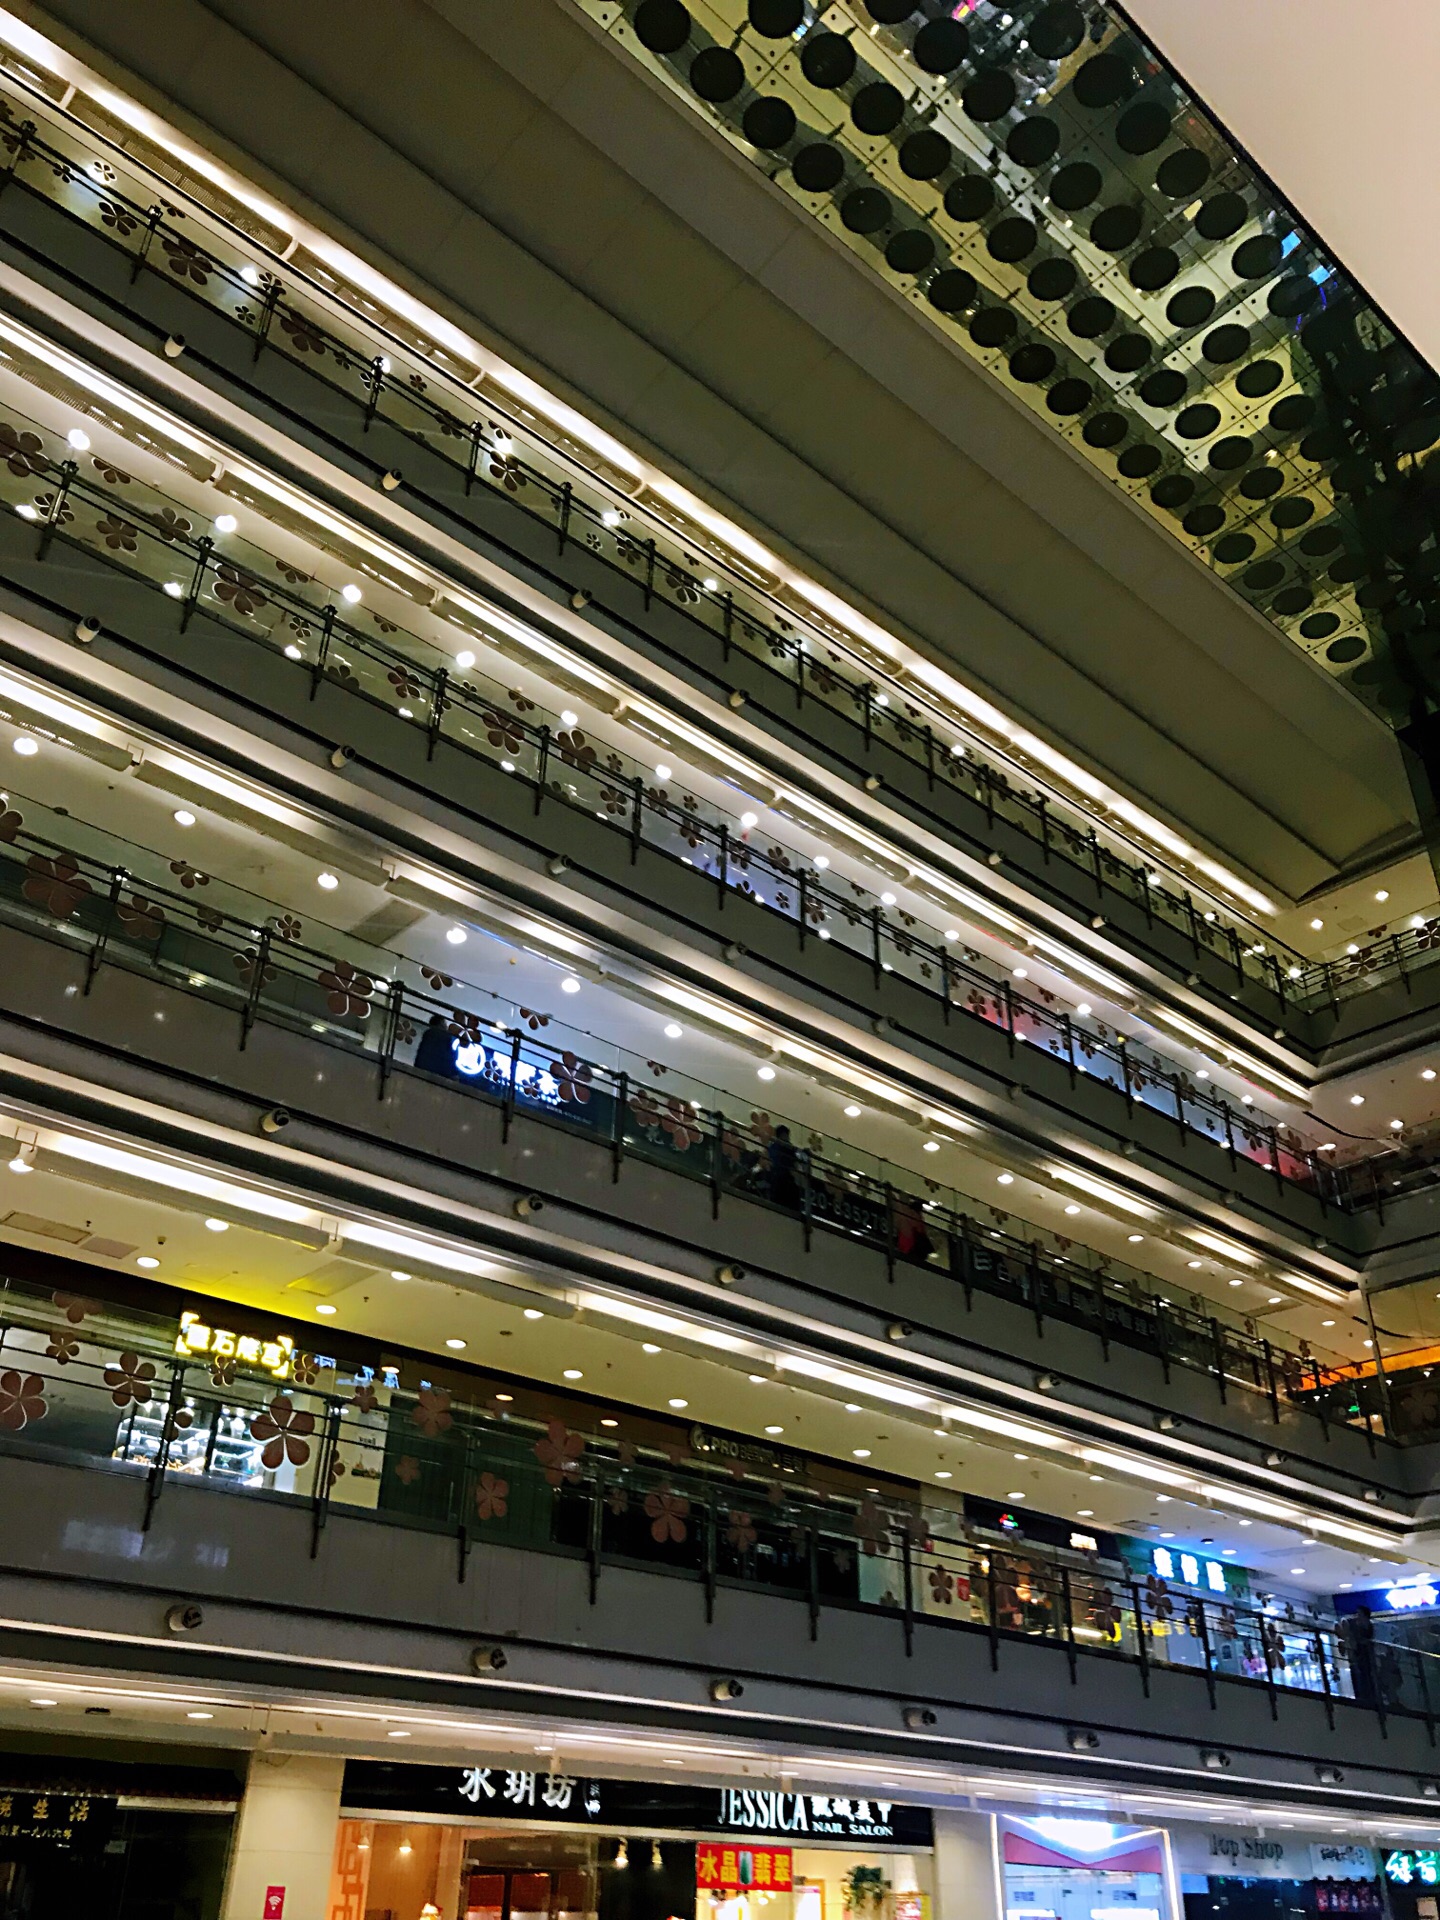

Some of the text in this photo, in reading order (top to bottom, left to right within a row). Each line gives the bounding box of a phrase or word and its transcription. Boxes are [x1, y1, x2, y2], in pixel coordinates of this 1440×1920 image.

[717, 1788, 809, 1832] JESSICA
[812, 1821, 894, 1837] NAIL SALON
